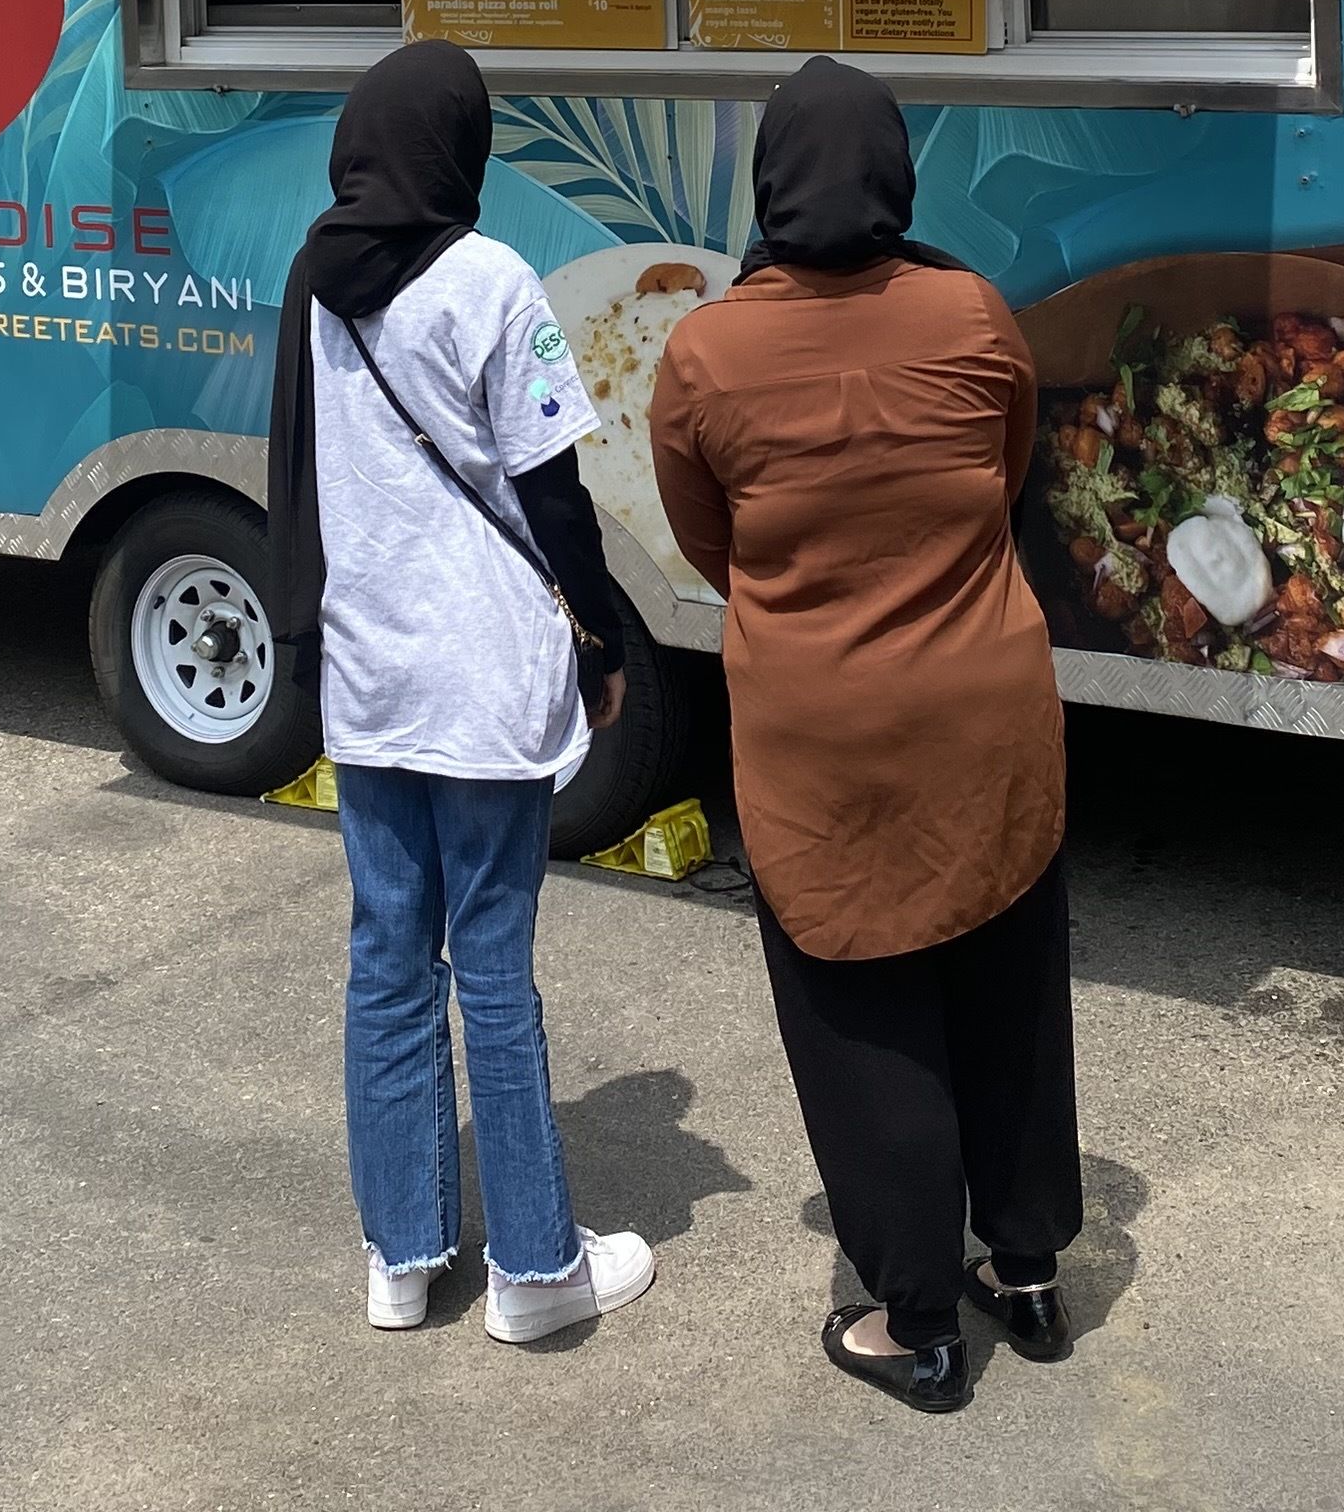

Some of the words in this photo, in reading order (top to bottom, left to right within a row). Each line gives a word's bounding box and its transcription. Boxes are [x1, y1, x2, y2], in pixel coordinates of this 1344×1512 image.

[426, 0, 475, 12] paradise
[478, 0, 506, 12] pizza
[509, 0, 536, 9] dosa
[539, 0, 558, 9] roll
[23, 263, 46, 296] &
[62, 266, 253, 312] BIRYANI
